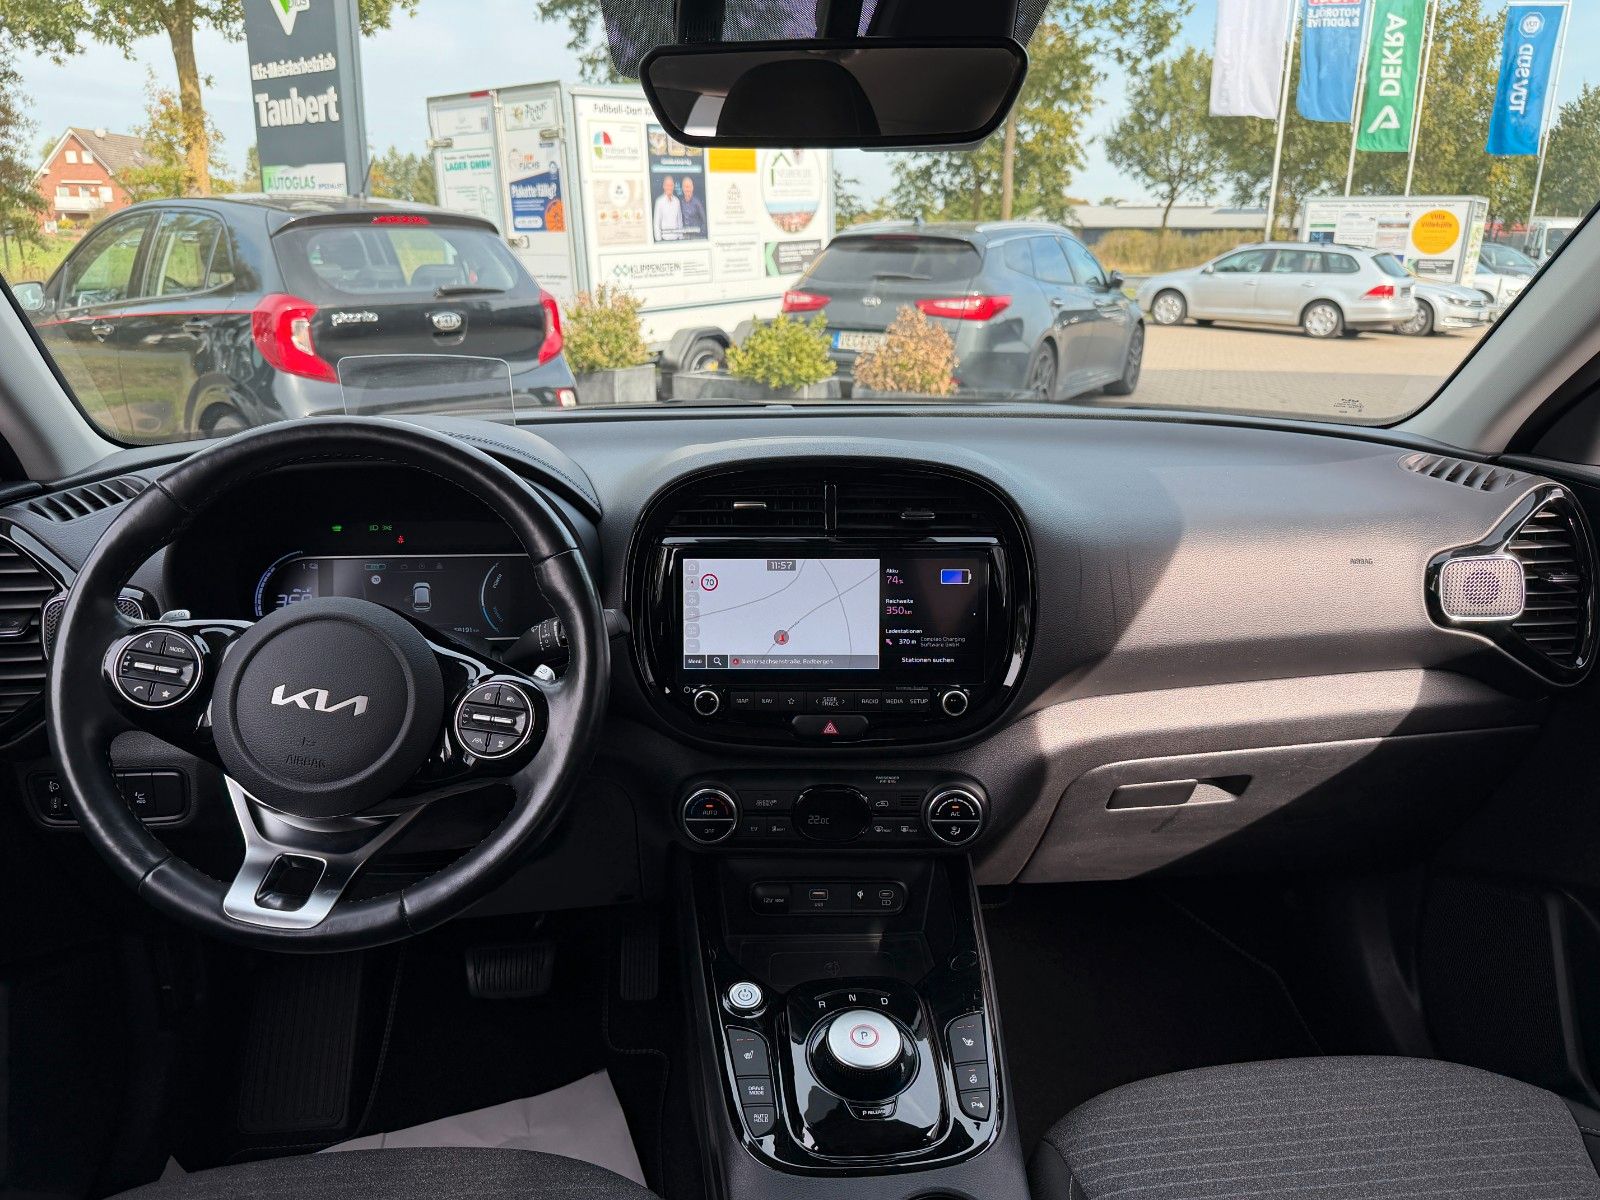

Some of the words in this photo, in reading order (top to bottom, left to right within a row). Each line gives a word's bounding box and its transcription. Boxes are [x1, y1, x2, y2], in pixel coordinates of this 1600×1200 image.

[251, 52, 336, 81] Kfz-Meisterbetrieb
[255, 85, 340, 128] Taubert
[268, 175, 316, 190] AUTOGLAS
[770, 561, 793, 570] 11:57
[704, 578, 715, 586] 70
[849, 994, 857, 1002] N
[881, 997, 888, 1005] D
[860, 1031, 868, 1040] P
